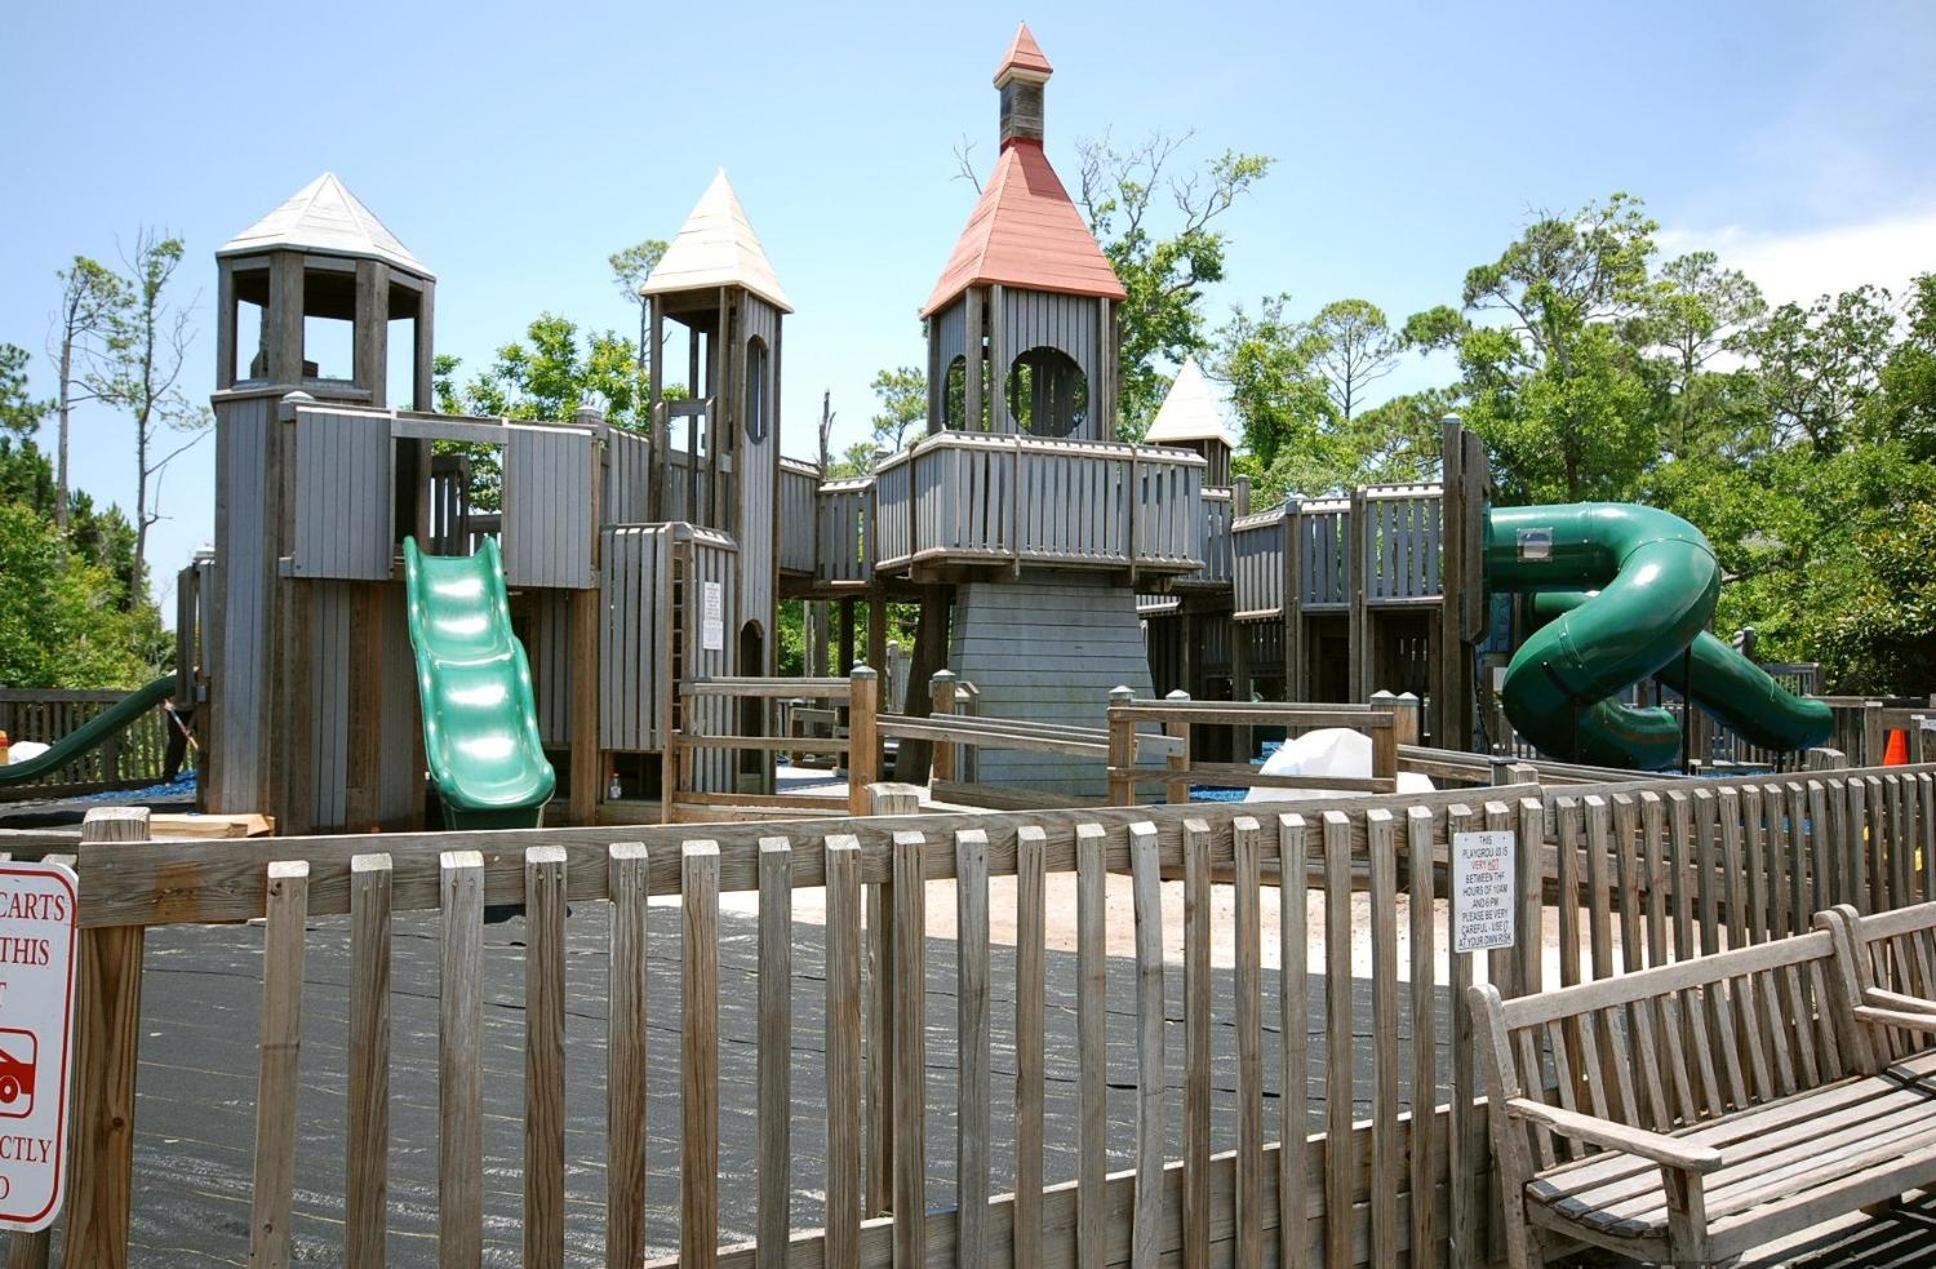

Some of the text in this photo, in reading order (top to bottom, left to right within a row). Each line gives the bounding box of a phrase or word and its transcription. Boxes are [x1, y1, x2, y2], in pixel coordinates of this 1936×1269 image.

[1479, 835, 1492, 845] THIS
[1472, 858, 1499, 871] VERY HOT
[1466, 872, 1493, 884] BETWEEN
[1463, 884, 1508, 897] HOURS OF 10AM
[0, 892, 65, 921] CARTS
[1472, 898, 1485, 908] AND
[1462, 908, 1508, 922] PLEASE BE VERY
[1461, 923, 1488, 936] CAREFUL
[1491, 921, 1503, 932] USE
[1458, 932, 1512, 947] AT YOUR OWN RISK
[0, 937, 50, 966] THIS
